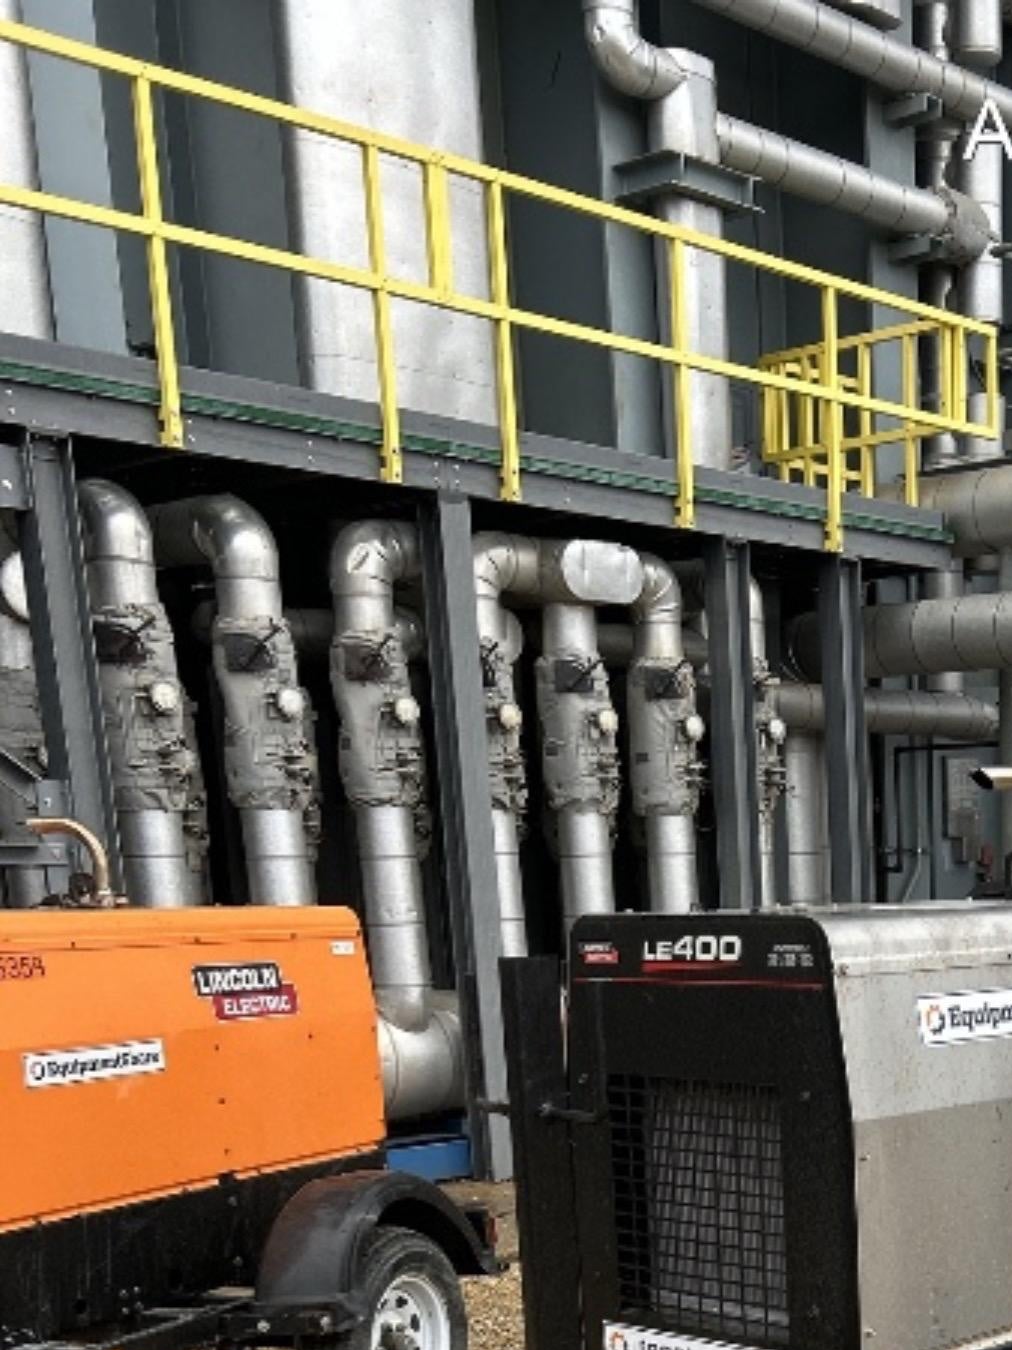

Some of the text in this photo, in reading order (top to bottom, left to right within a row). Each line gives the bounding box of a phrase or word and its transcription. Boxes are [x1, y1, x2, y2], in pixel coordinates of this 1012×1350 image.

[643, 934, 742, 962] LE400
[197, 967, 280, 995] LINCOLN
[222, 995, 292, 1015] ELECTRIC
